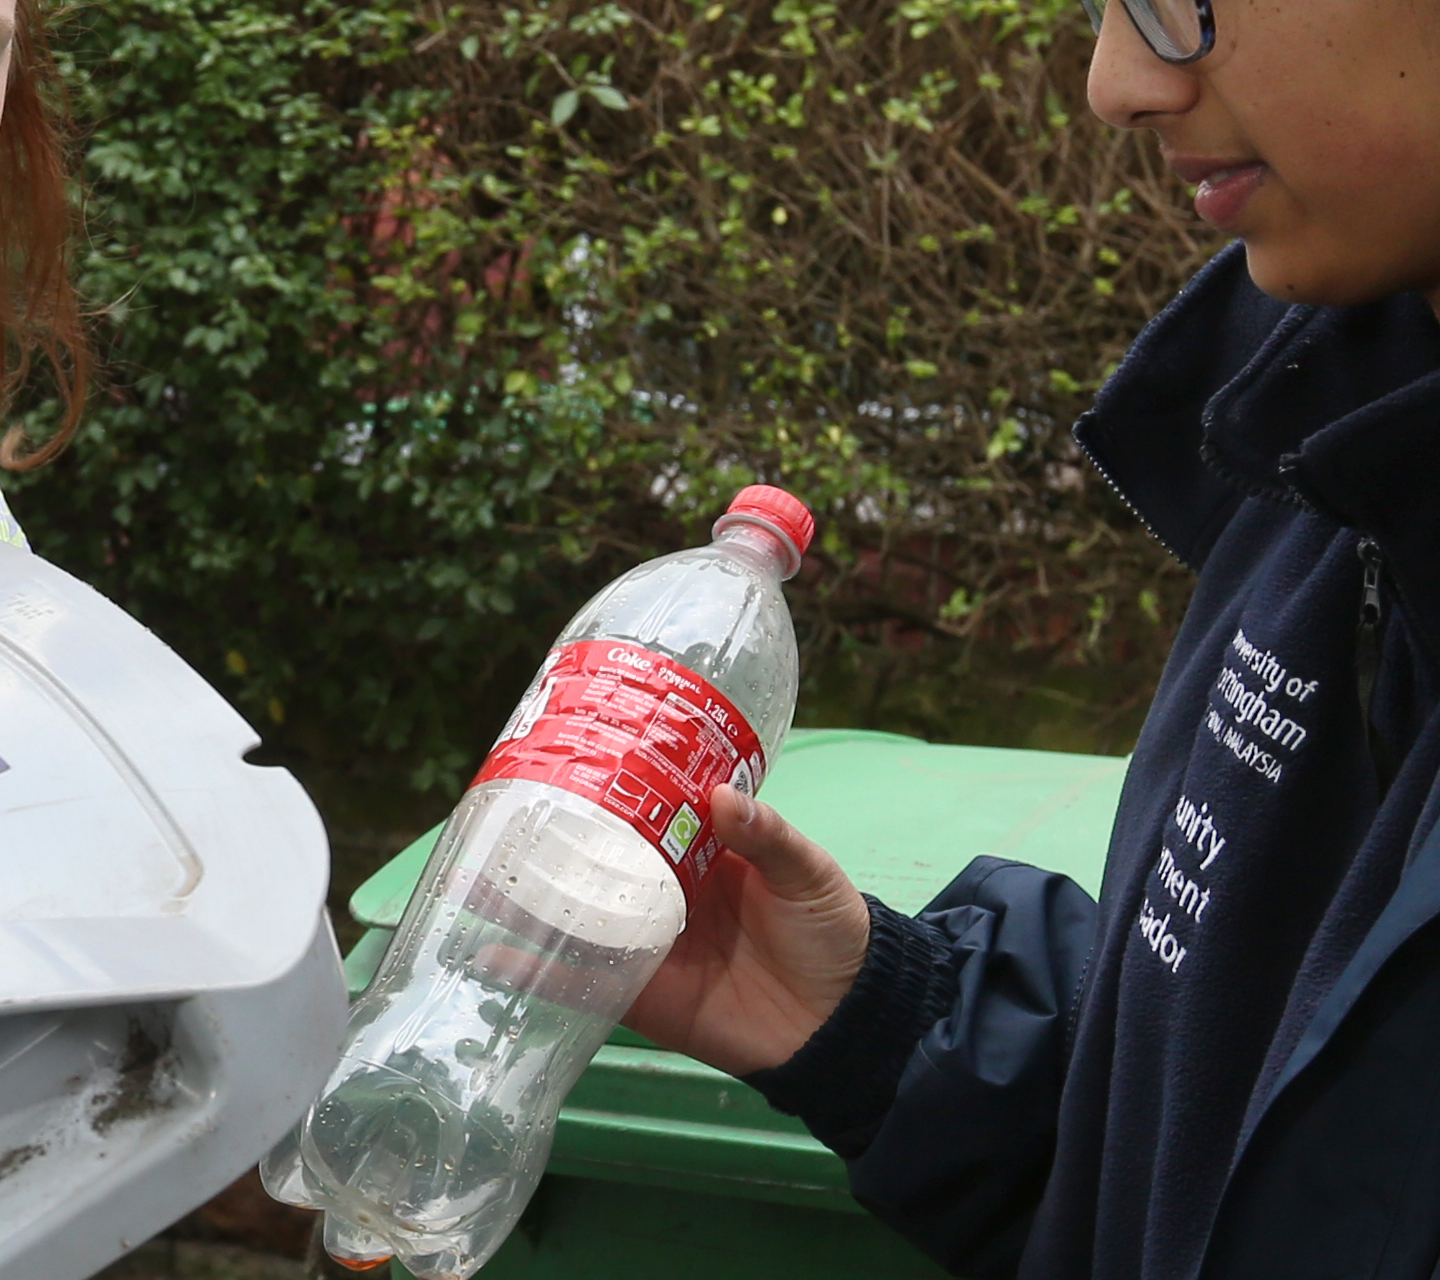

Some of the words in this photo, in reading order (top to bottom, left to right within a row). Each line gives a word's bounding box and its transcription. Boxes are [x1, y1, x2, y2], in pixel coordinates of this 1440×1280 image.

[607, 647, 652, 671] Coke
[657, 672, 685, 691] TASTE
[659, 666, 702, 694] ORIGINAL
[1285, 677, 1320, 703] of
[704, 697, 730, 728] 1.25L
[1222, 726, 1283, 784] MALAYSIA
